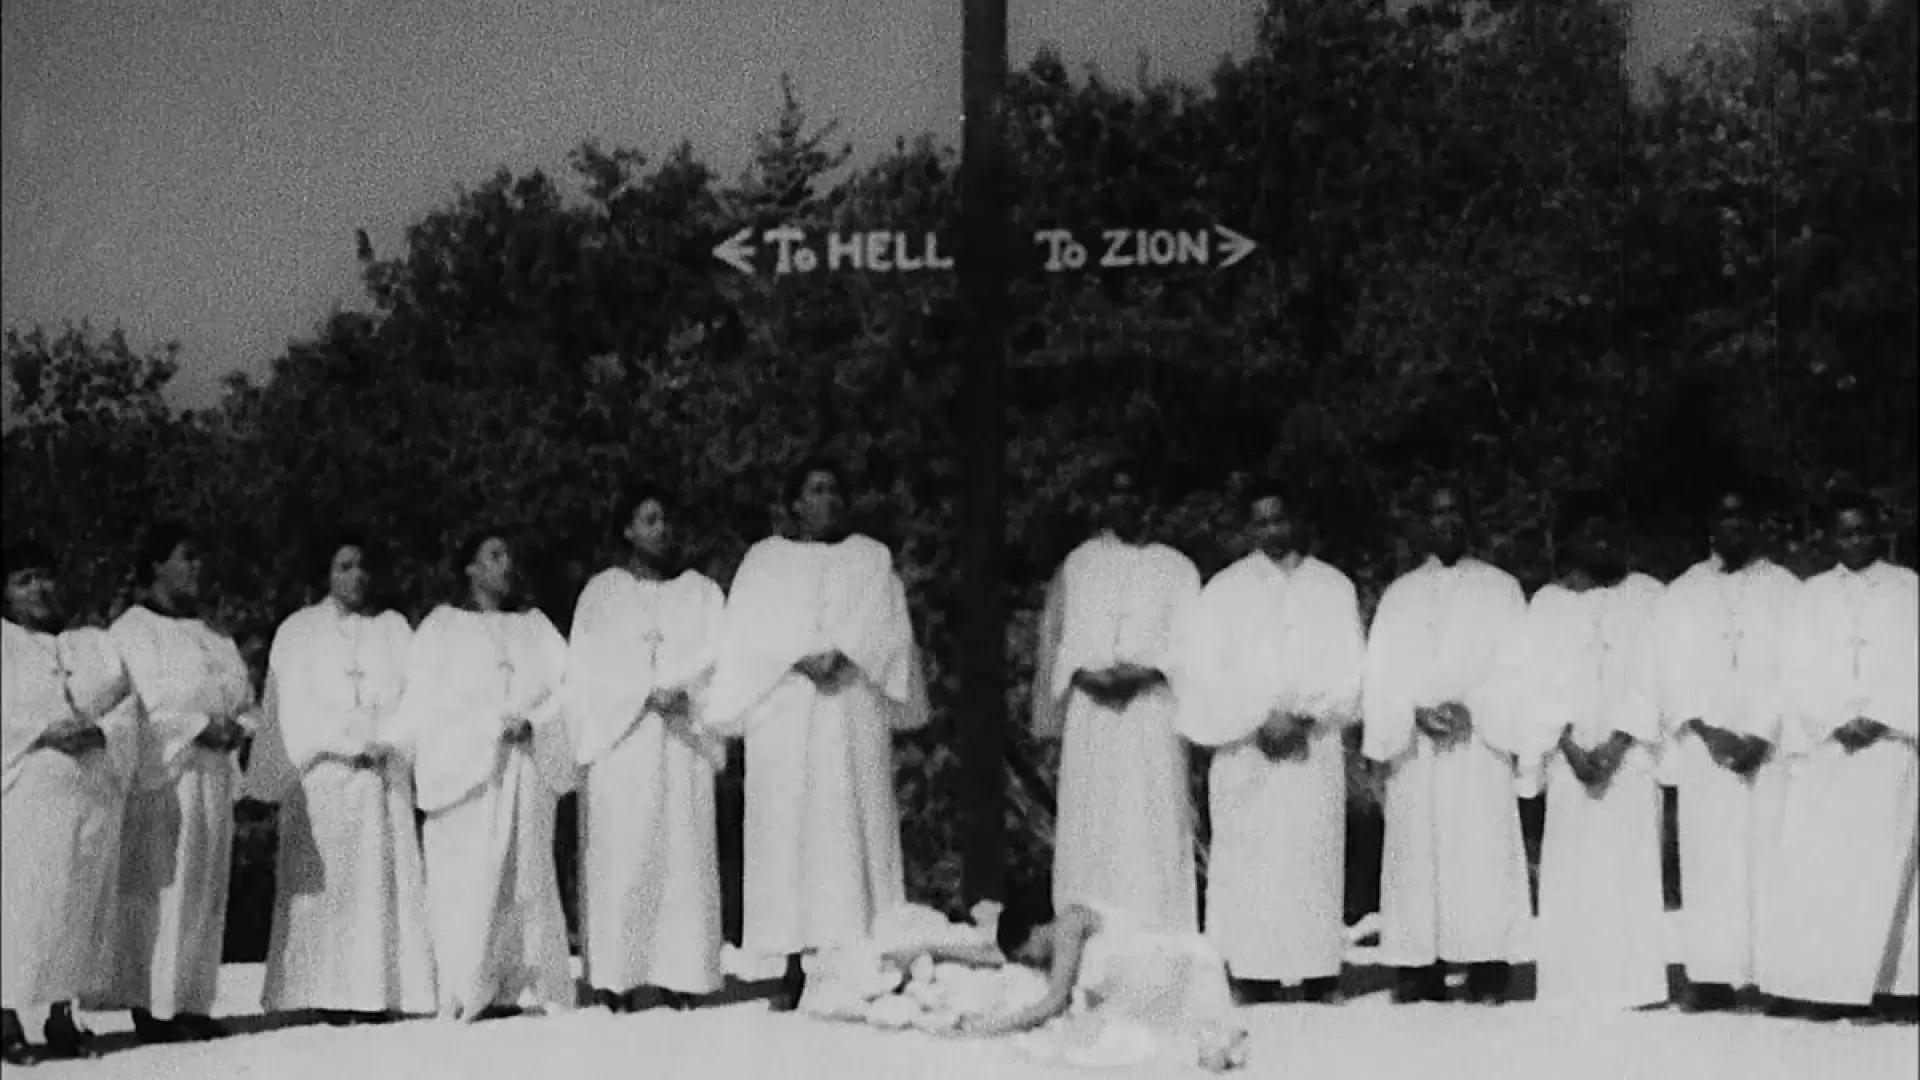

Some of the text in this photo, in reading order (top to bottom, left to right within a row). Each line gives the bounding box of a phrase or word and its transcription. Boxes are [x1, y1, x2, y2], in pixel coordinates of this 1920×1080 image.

[764, 225, 954, 273] To HELL
[1036, 230, 1209, 271] To ZION
